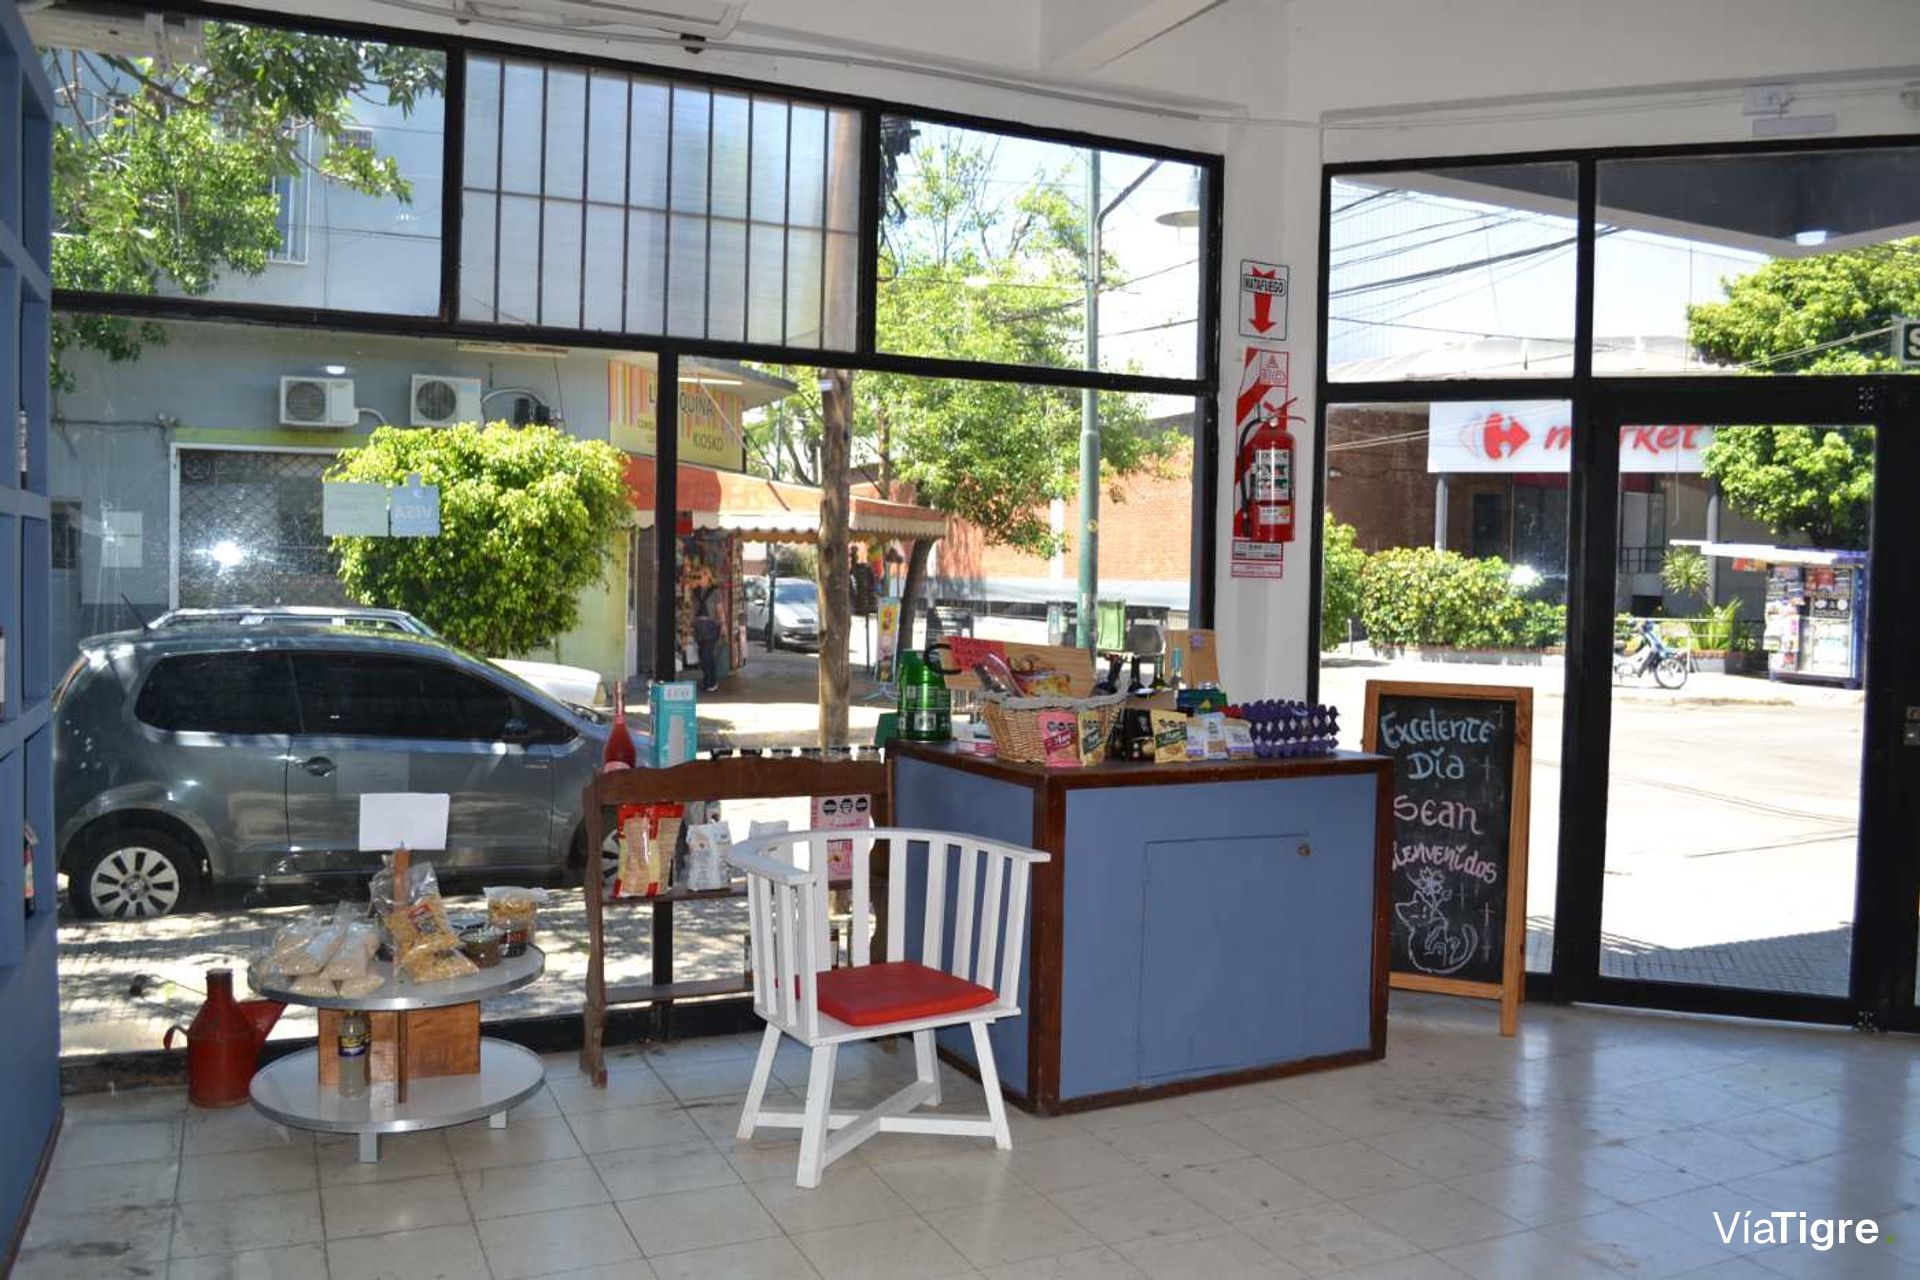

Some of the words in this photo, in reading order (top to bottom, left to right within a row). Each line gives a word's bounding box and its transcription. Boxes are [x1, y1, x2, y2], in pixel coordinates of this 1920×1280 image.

[1245, 277, 1284, 294] MATAFUEGO
[679, 391, 713, 417] QUINA
[693, 432, 724, 452] KIOSKO
[1543, 424, 1702, 456] mrket
[1391, 840, 1498, 884] ienvenidos
